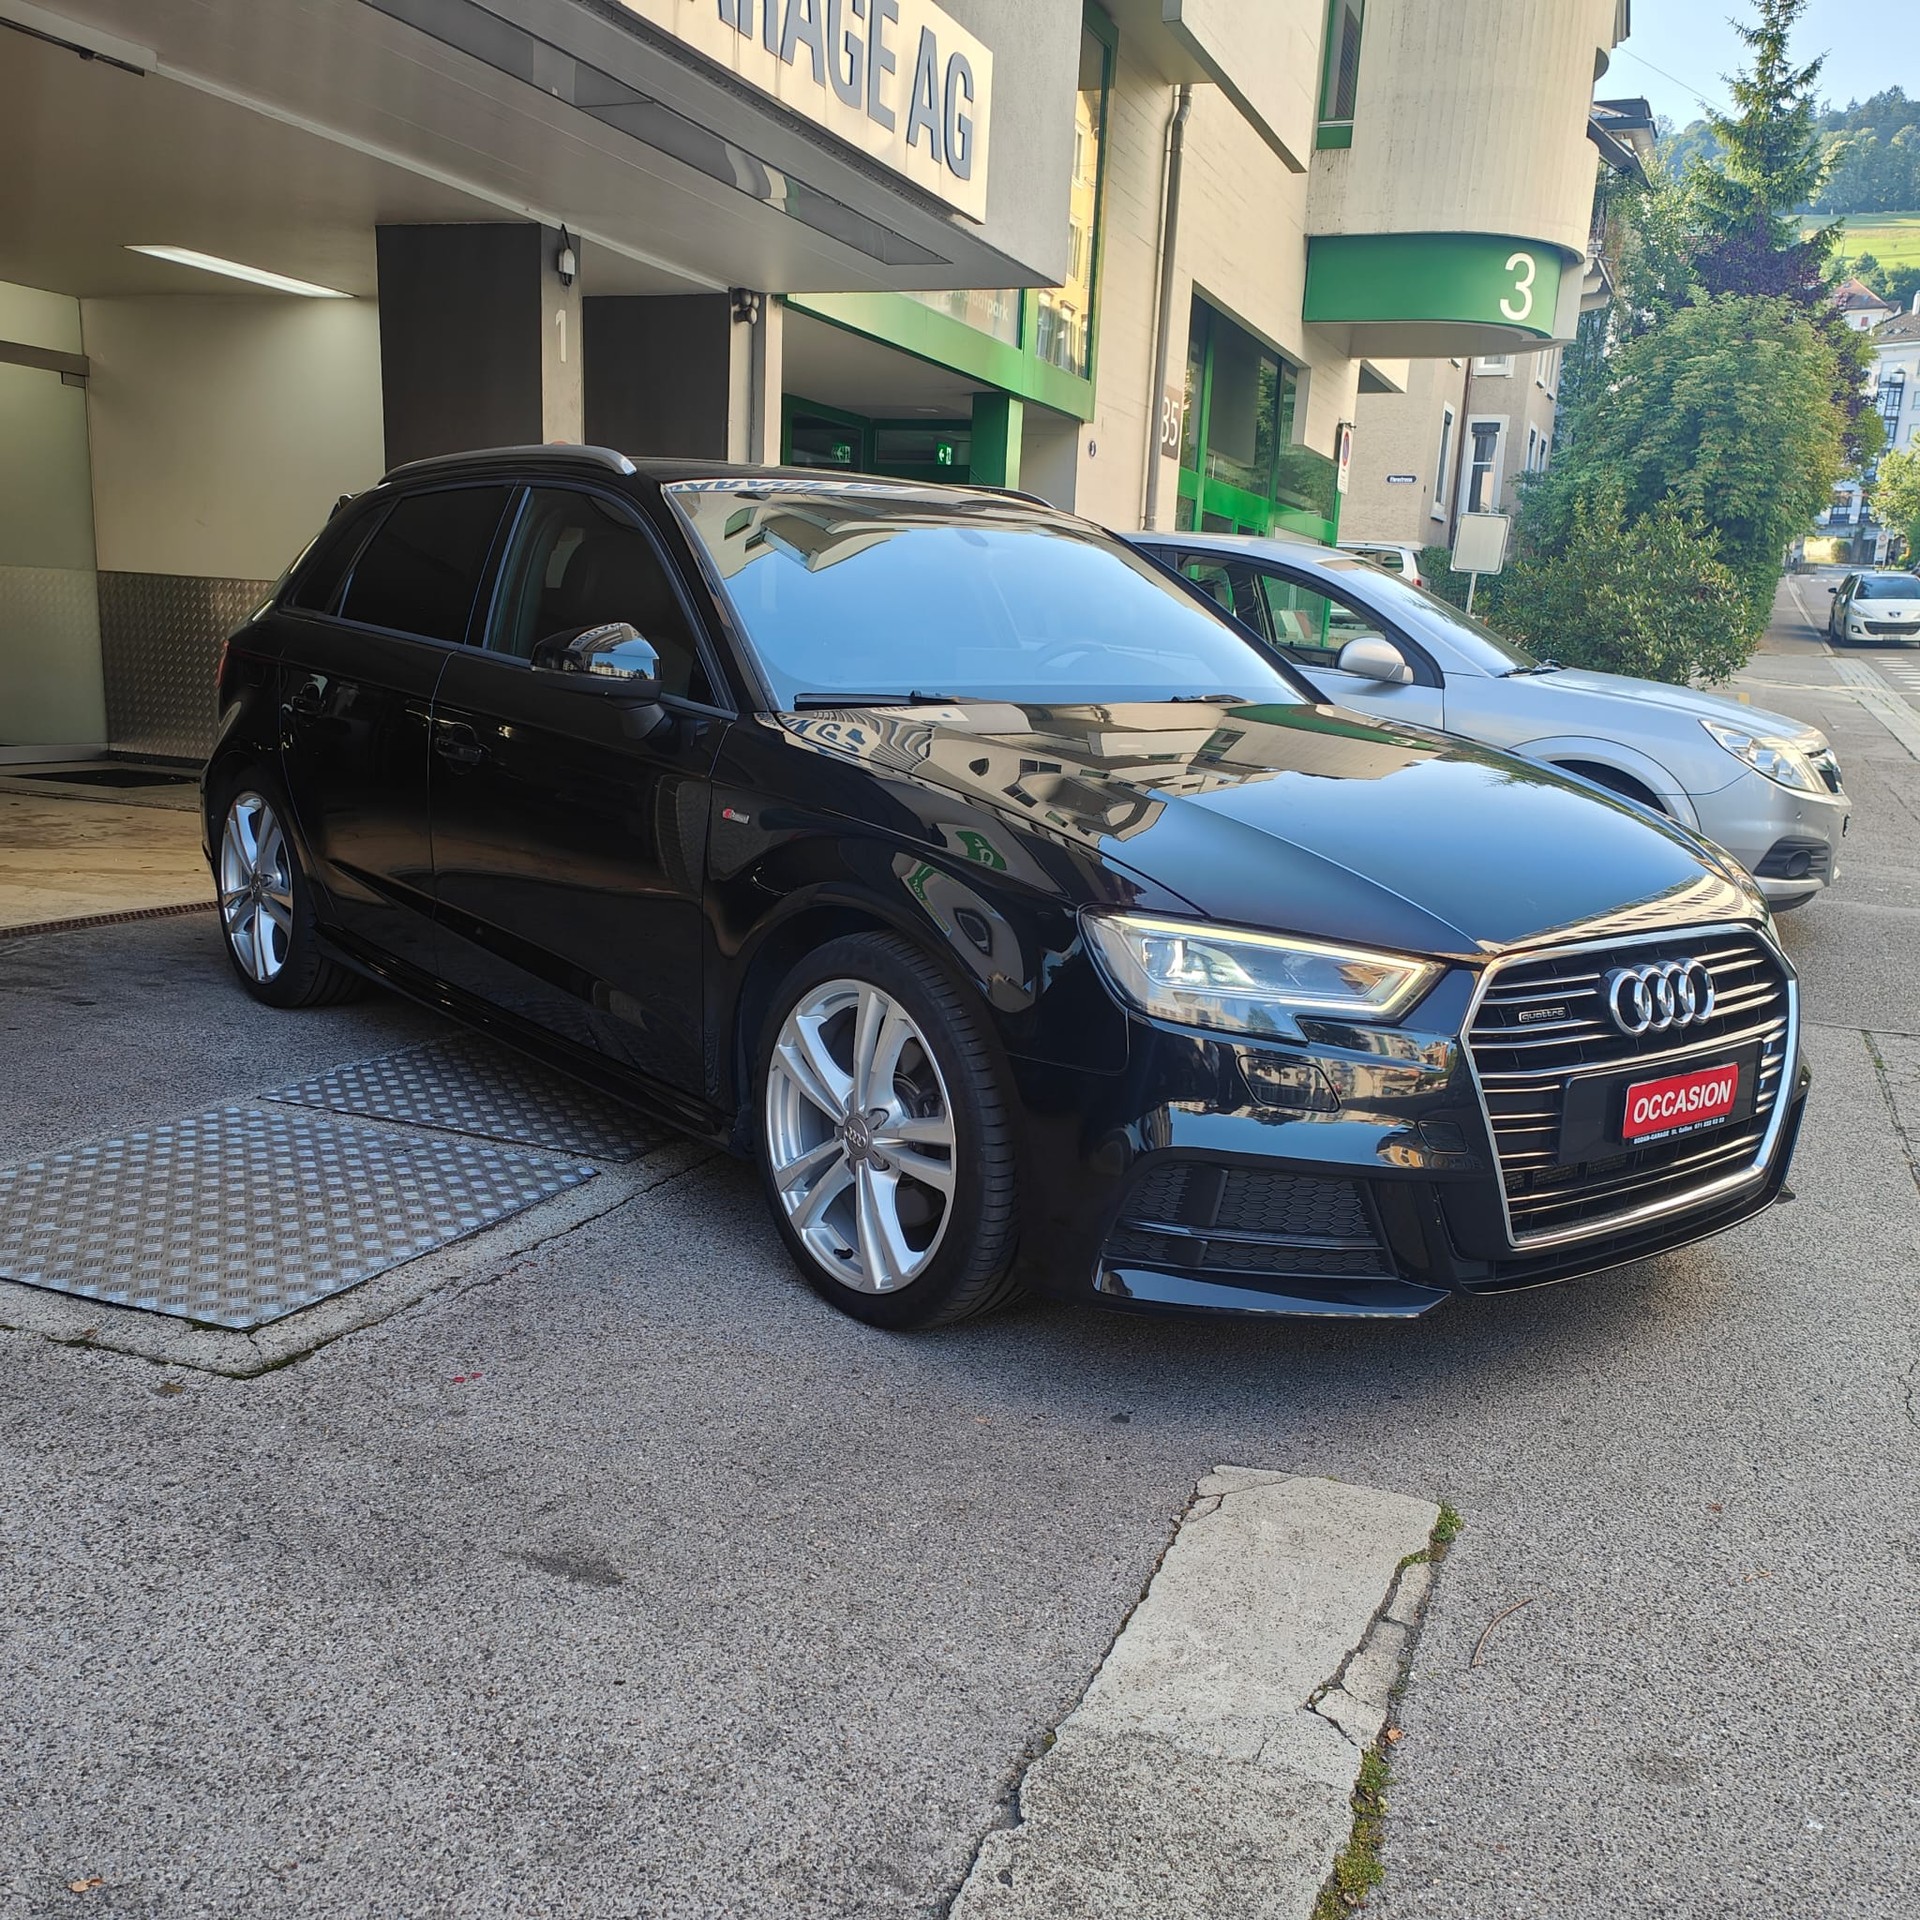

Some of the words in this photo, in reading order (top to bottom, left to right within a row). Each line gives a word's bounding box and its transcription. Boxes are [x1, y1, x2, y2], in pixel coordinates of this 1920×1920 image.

[906, 25, 974, 182] AG
[1499, 252, 1536, 321] 3
[555, 309, 567, 363] 1
[1633, 1079, 1732, 1123] OCCASION
